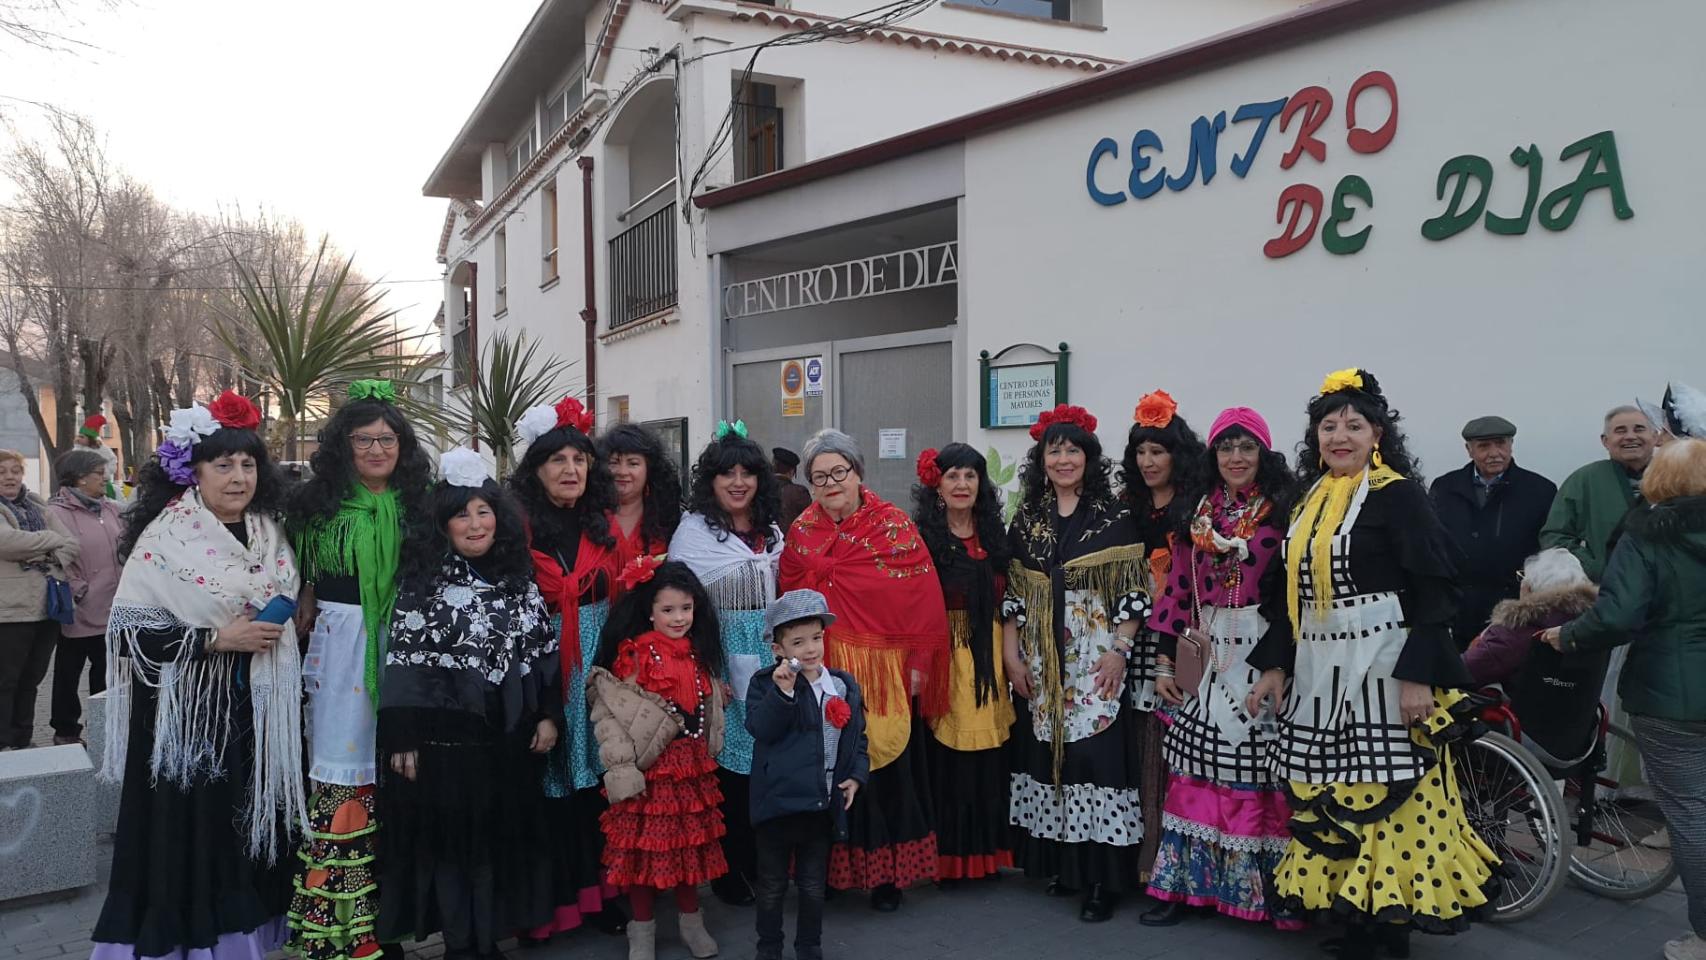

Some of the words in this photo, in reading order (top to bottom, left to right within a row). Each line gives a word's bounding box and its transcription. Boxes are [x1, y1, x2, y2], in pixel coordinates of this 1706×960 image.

[1086, 70, 1399, 206] CENTRO
[1263, 174, 1374, 258] DE
[725, 265, 838, 318] CENTRO
[846, 255, 888, 299] DE
[900, 242, 958, 291] DIA
[1000, 381, 1028, 390] CENTRO
[1029, 379, 1039, 388] DE
[1003, 391, 1013, 400] DE
[1014, 388, 1050, 399] PERSONAS
[1010, 400, 1043, 409] MAYORES
